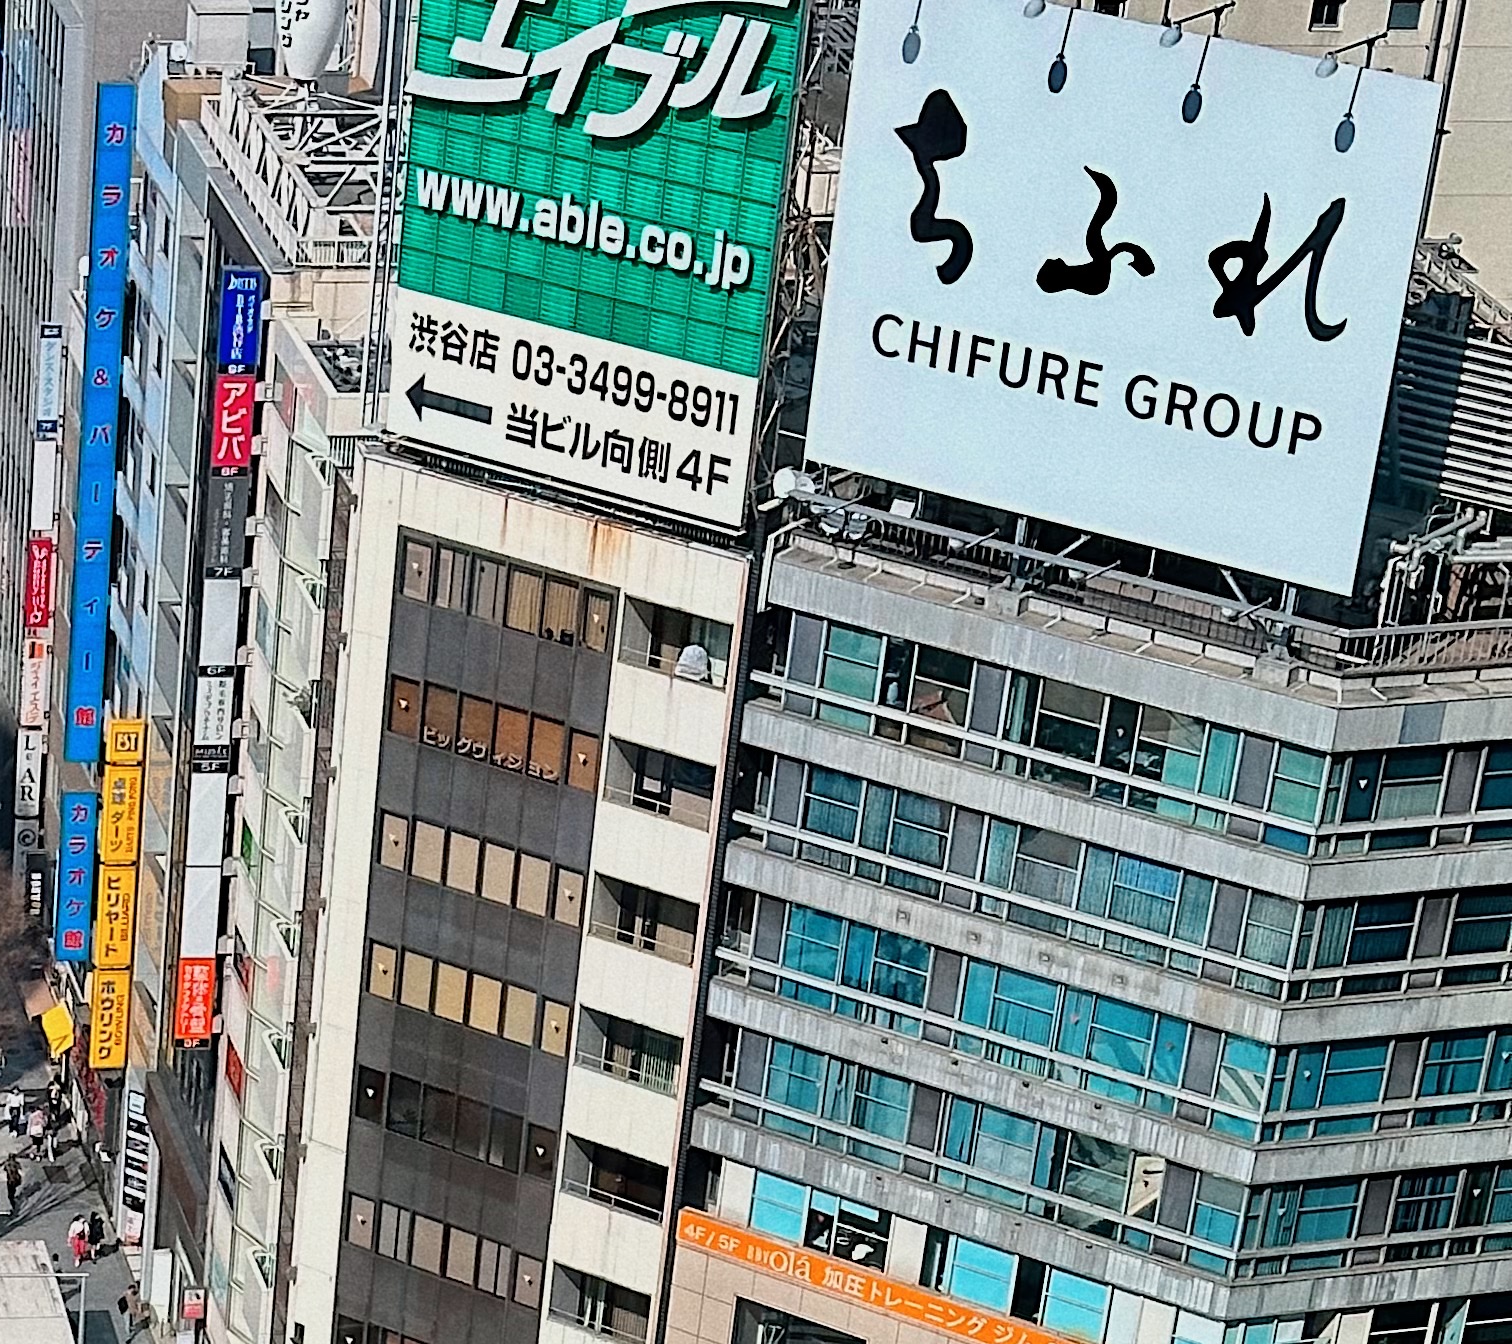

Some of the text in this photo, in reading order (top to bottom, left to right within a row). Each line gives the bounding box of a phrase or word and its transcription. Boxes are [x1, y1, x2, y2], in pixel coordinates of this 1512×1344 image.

[406, 0, 778, 137] エイブル
[414, 169, 755, 289] www.able.co.jp
[893, 87, 1349, 342] ちふれ
[217, 382, 248, 460] アビバ
[408, 312, 740, 436] 渋谷店 03-3499-8911
[871, 312, 1323, 457] CHIFURE GROUP
[503, 406, 733, 497] 当ビル向側 4F
[213, 567, 233, 577] 7F
[62, 804, 88, 949] カラオケ館
[821, 1265, 989, 1336] 加圧トレーニング
